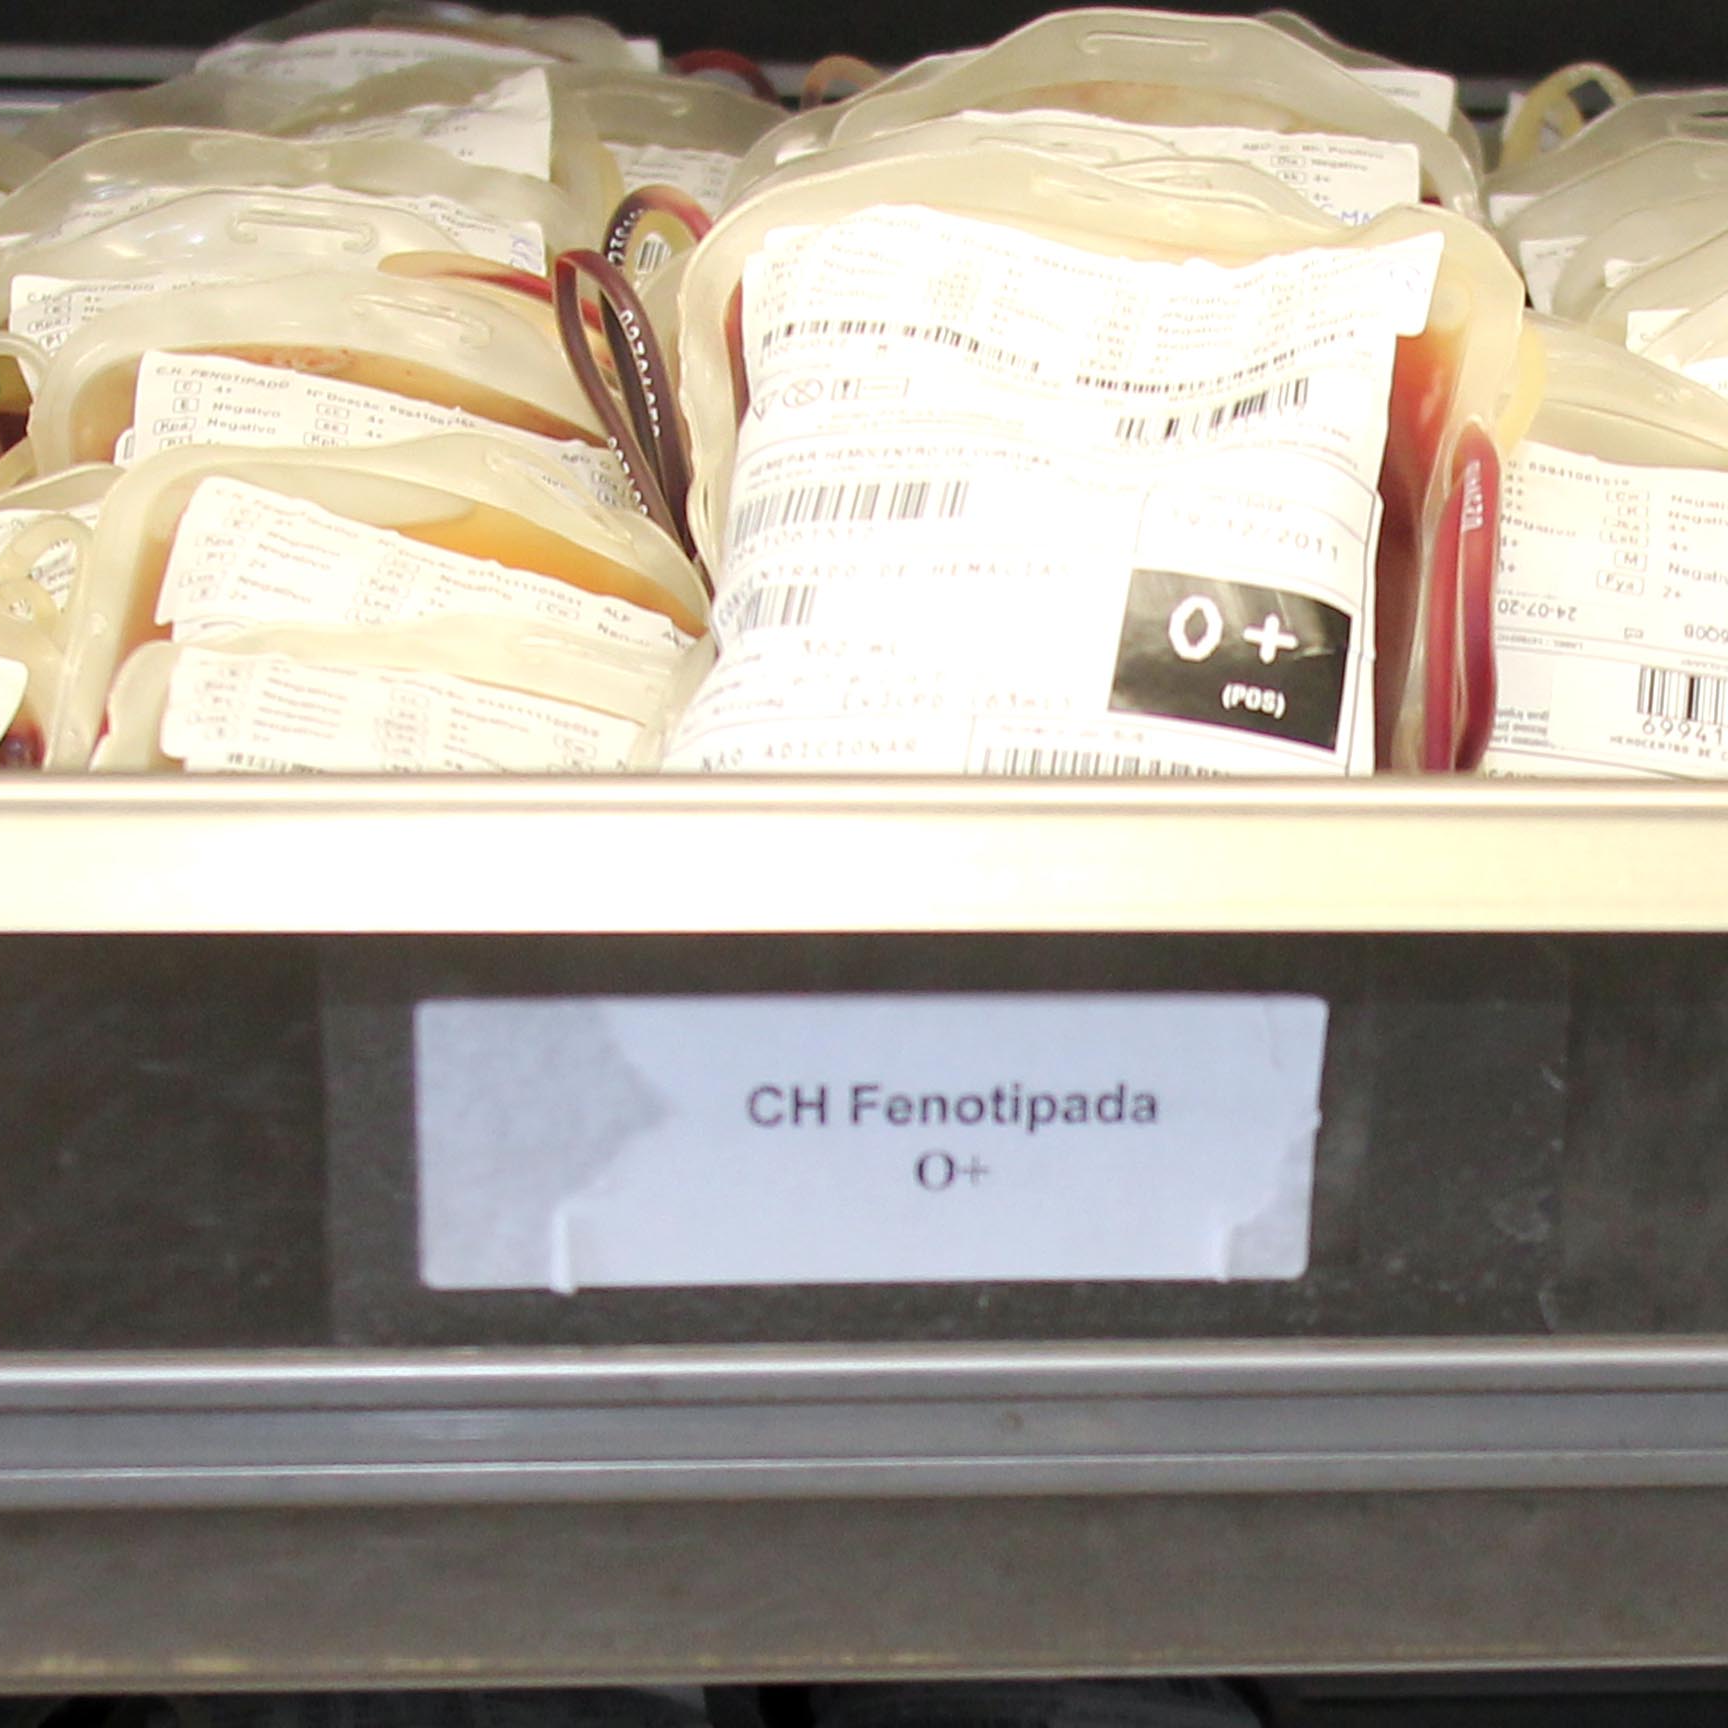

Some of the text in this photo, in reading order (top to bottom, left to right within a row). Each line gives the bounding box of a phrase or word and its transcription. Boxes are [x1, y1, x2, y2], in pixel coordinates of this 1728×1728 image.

[1221, 682, 1287, 720] (POS)
[746, 1082, 1159, 1135] CH Fenotipada
[915, 1150, 990, 1192] O+
